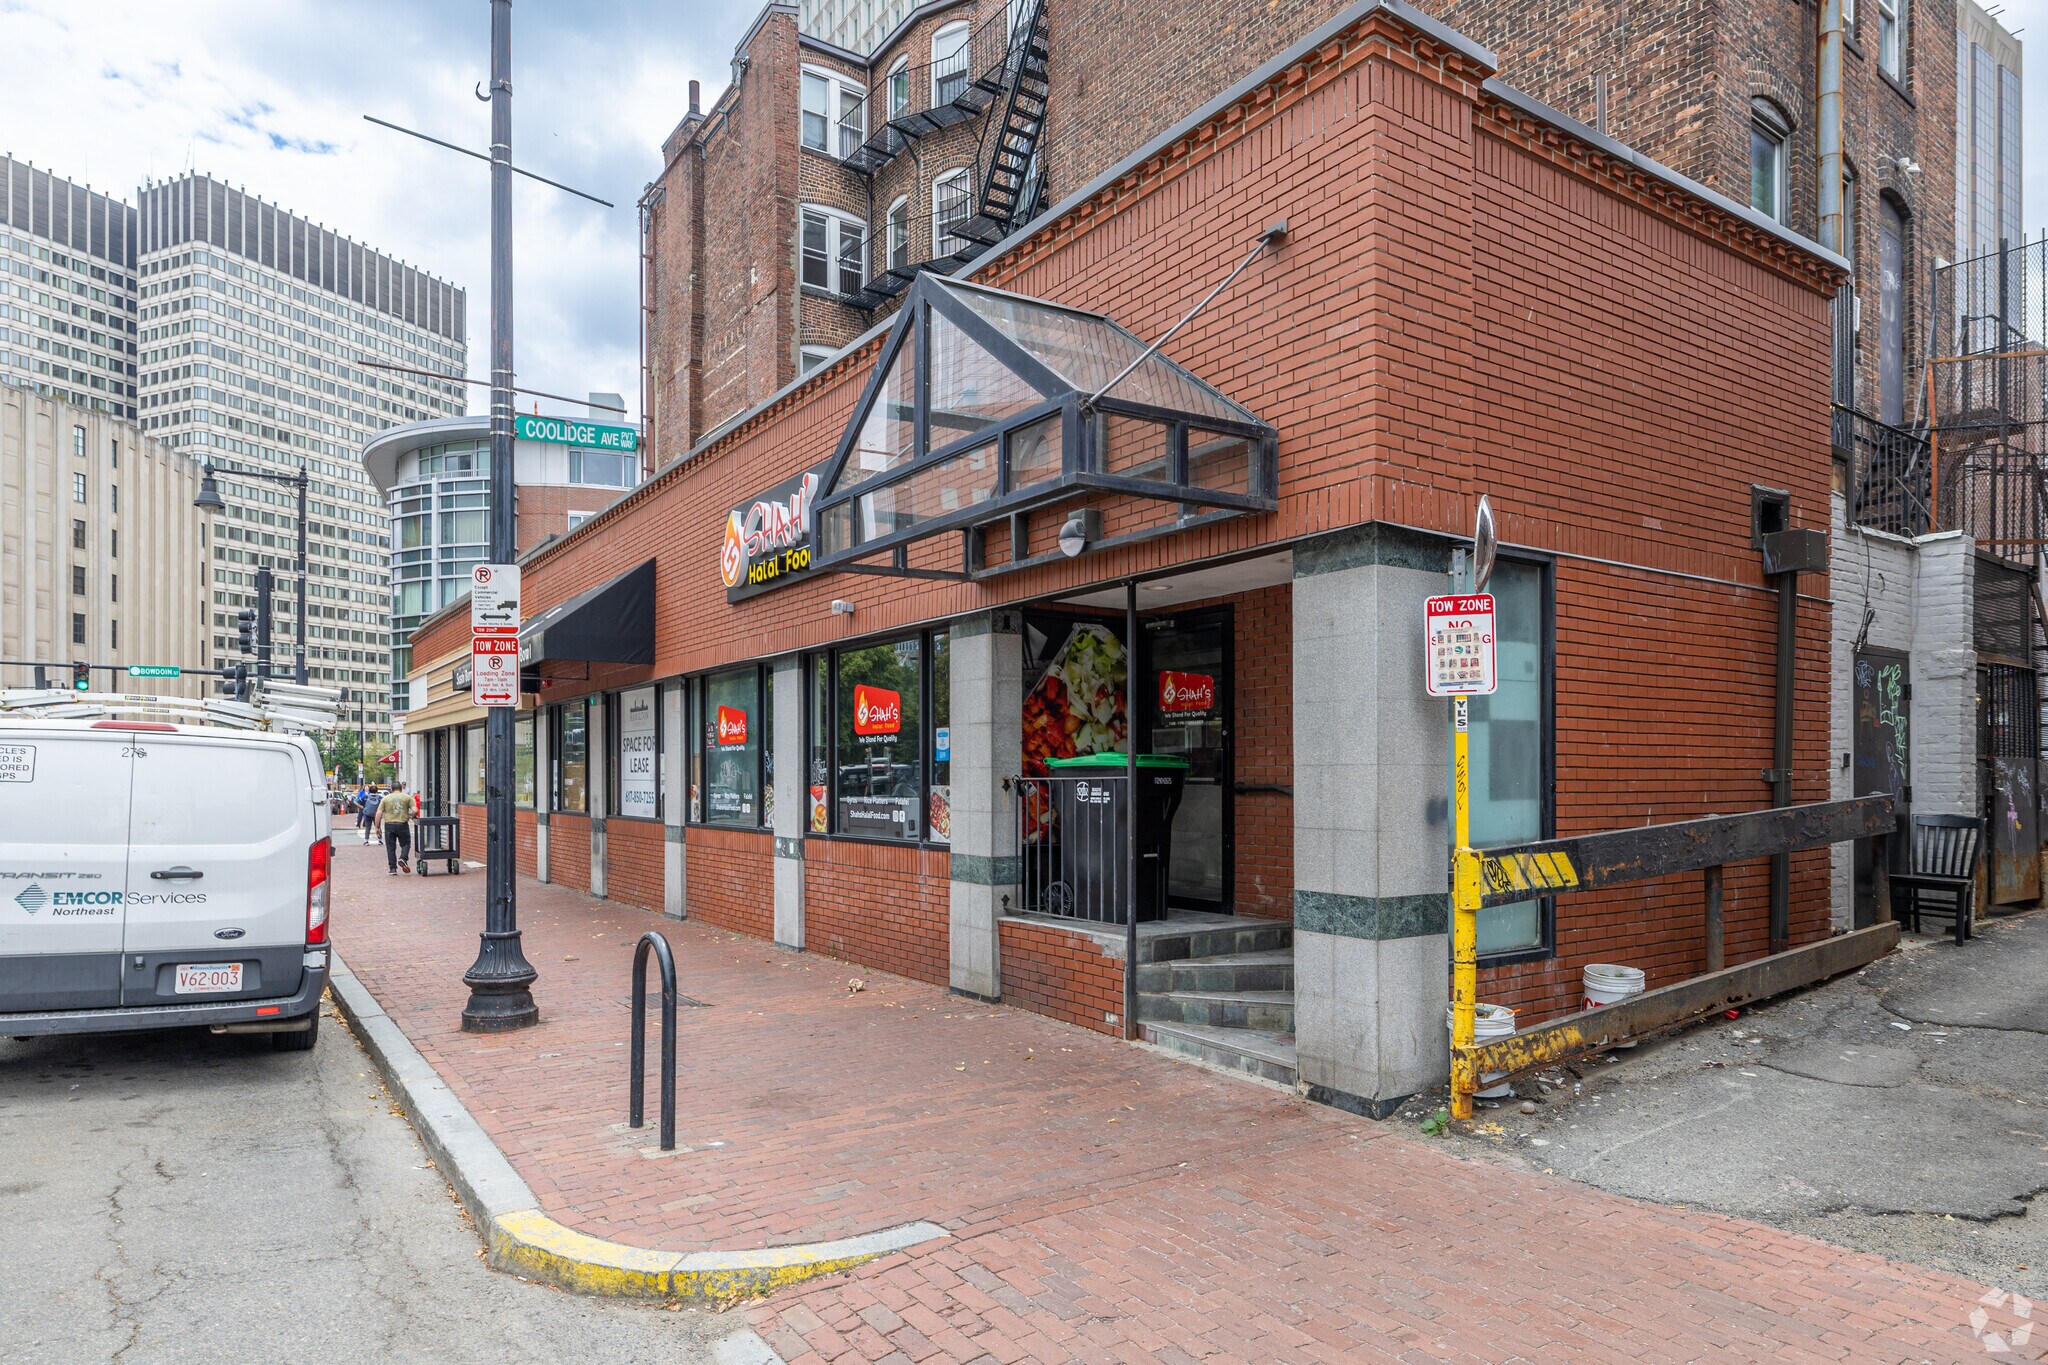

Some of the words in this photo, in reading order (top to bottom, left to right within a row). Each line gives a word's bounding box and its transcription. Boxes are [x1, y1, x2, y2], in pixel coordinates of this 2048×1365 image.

[525, 420, 596, 444] COOLIDGE
[601, 432, 620, 446] AVE
[621, 432, 634, 440] PVT
[620, 440, 634, 448] WAY
[748, 555, 780, 585] Halal
[786, 549, 810, 572] Foo
[1430, 600, 1453, 612] TOW
[1459, 599, 1491, 612] ZONE
[475, 641, 491, 651] TOW
[494, 640, 516, 651] ZONE
[1176, 684, 1211, 700] SHAH'S
[869, 702, 898, 722] SHAH'S
[623, 737, 641, 752] SPACE
[884, 735, 897, 743] Quality
[630, 758, 649, 772] LEASE
[53, 891, 124, 905] EMCOR
[126, 892, 207, 905] Services
[52, 907, 114, 916] Northeast
